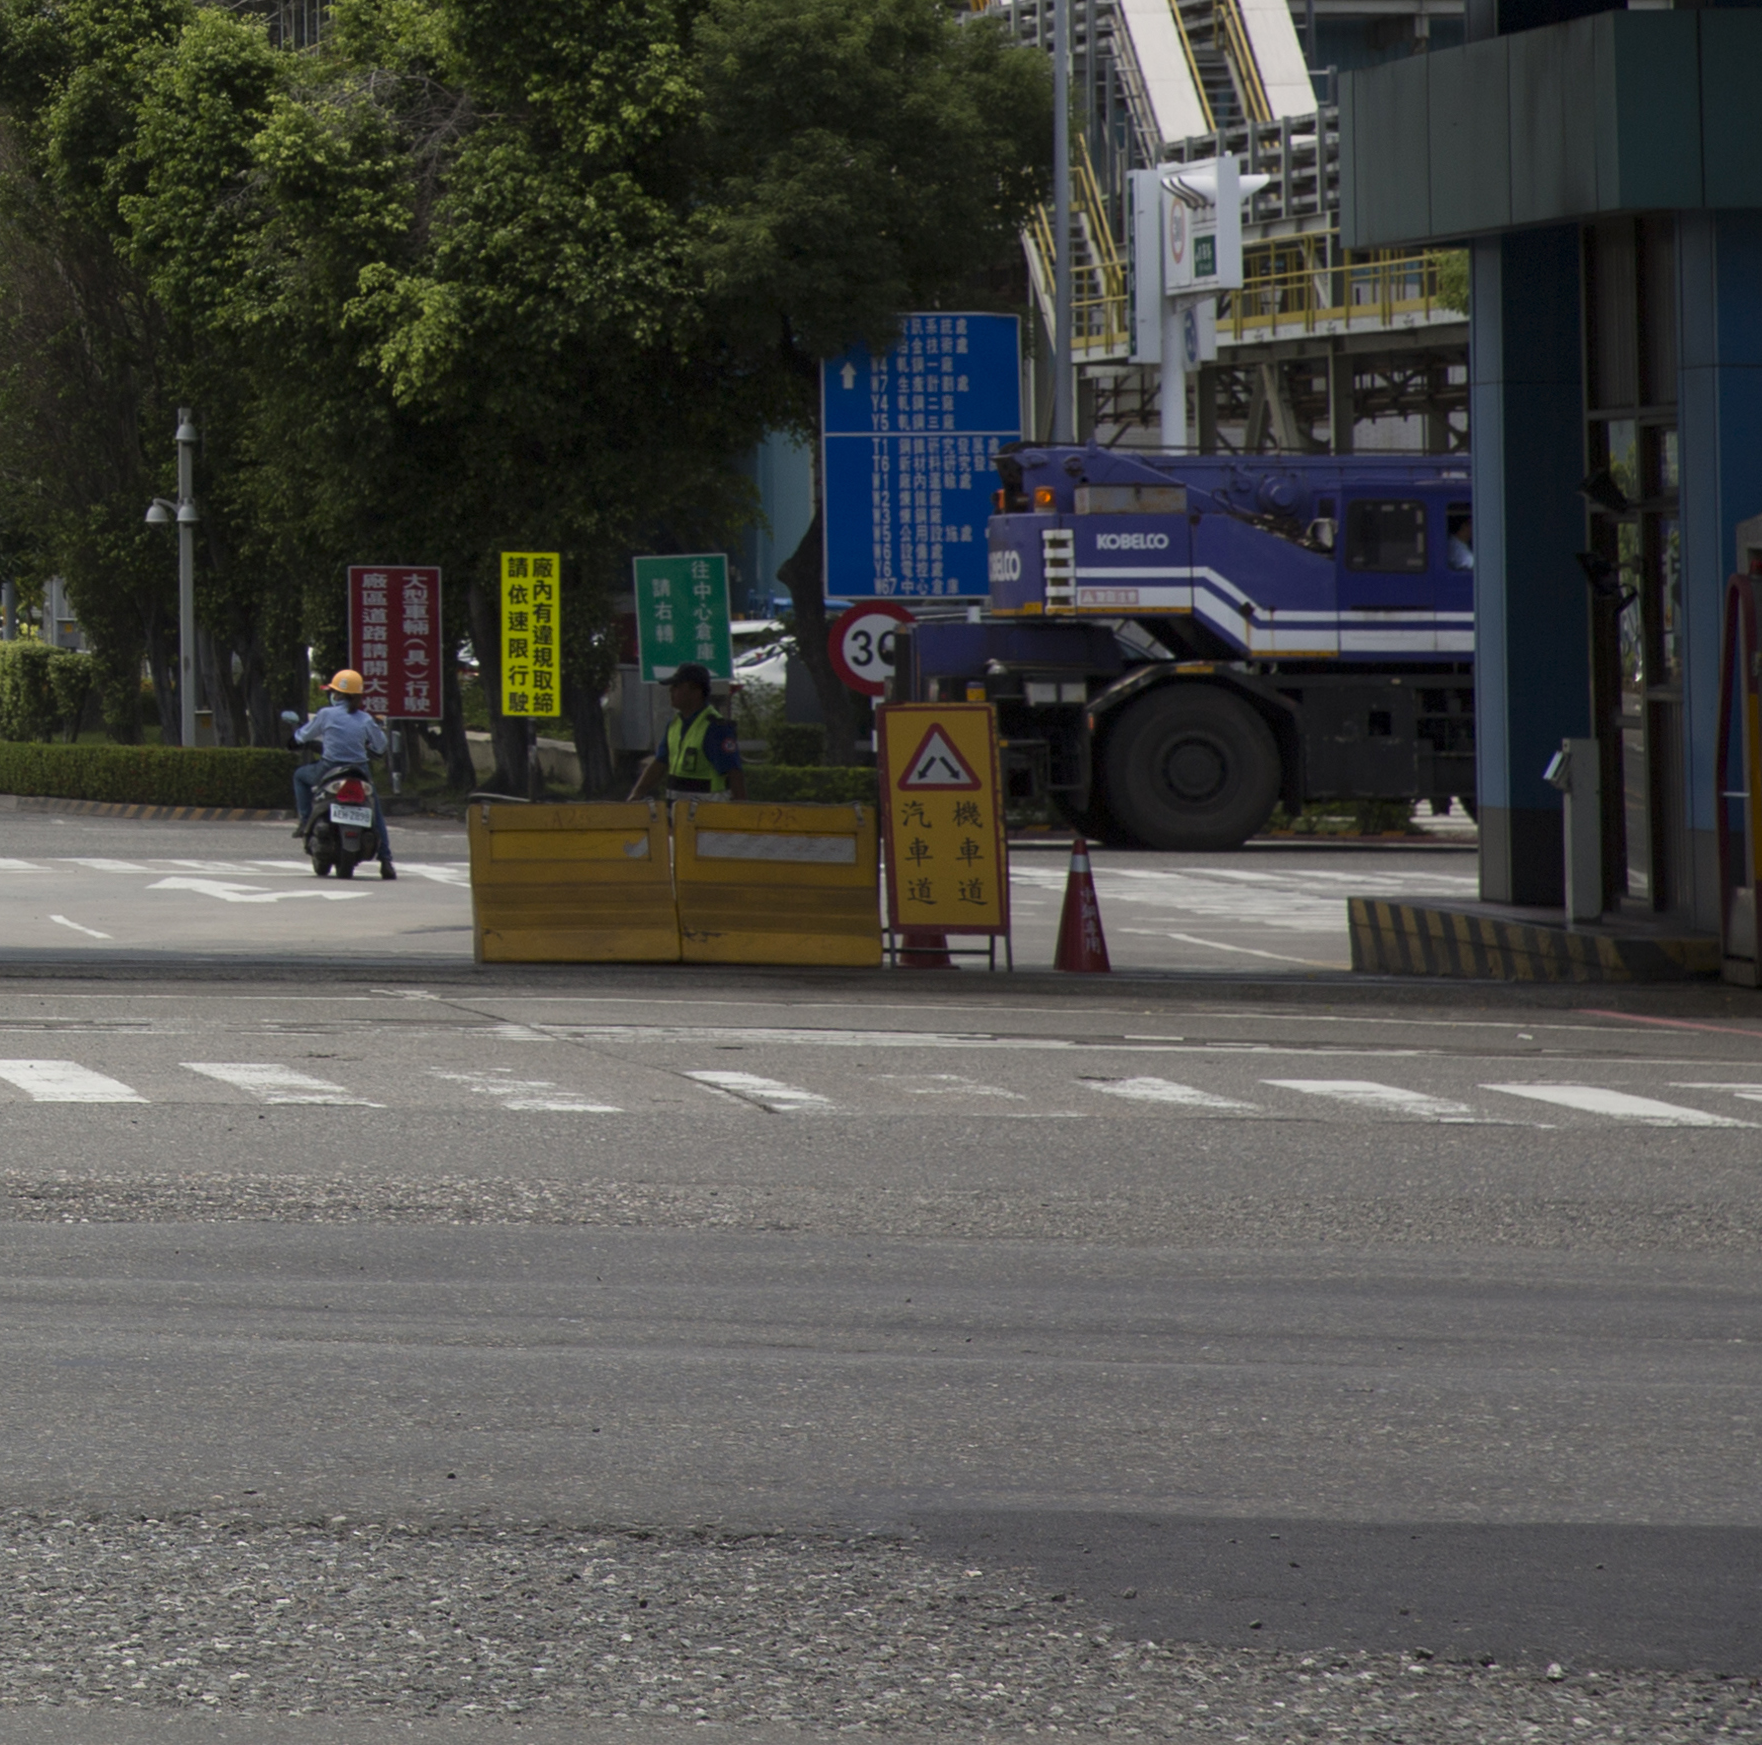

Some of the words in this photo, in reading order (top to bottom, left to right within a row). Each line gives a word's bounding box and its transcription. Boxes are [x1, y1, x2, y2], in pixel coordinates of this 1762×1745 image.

[870, 394, 889, 412] Y4
[871, 413, 890, 431] Y5
[872, 438, 888, 454] T1
[872, 456, 890, 472] T6
[1096, 533, 1169, 549] KOBELCO
[873, 561, 893, 577] Y6
[900, 577, 960, 595] 中心倉庫
[651, 578, 674, 643] 請右轉
[691, 560, 715, 661] 往中心倉庫
[361, 573, 389, 713] 廠區道路請開大燈
[507, 556, 529, 713] 請依速限行駛
[532, 557, 554, 714] 廠內有違規取締
[850, 629, 896, 667] 30
[901, 801, 937, 906] 汽車道
[952, 800, 988, 906] 機車道
